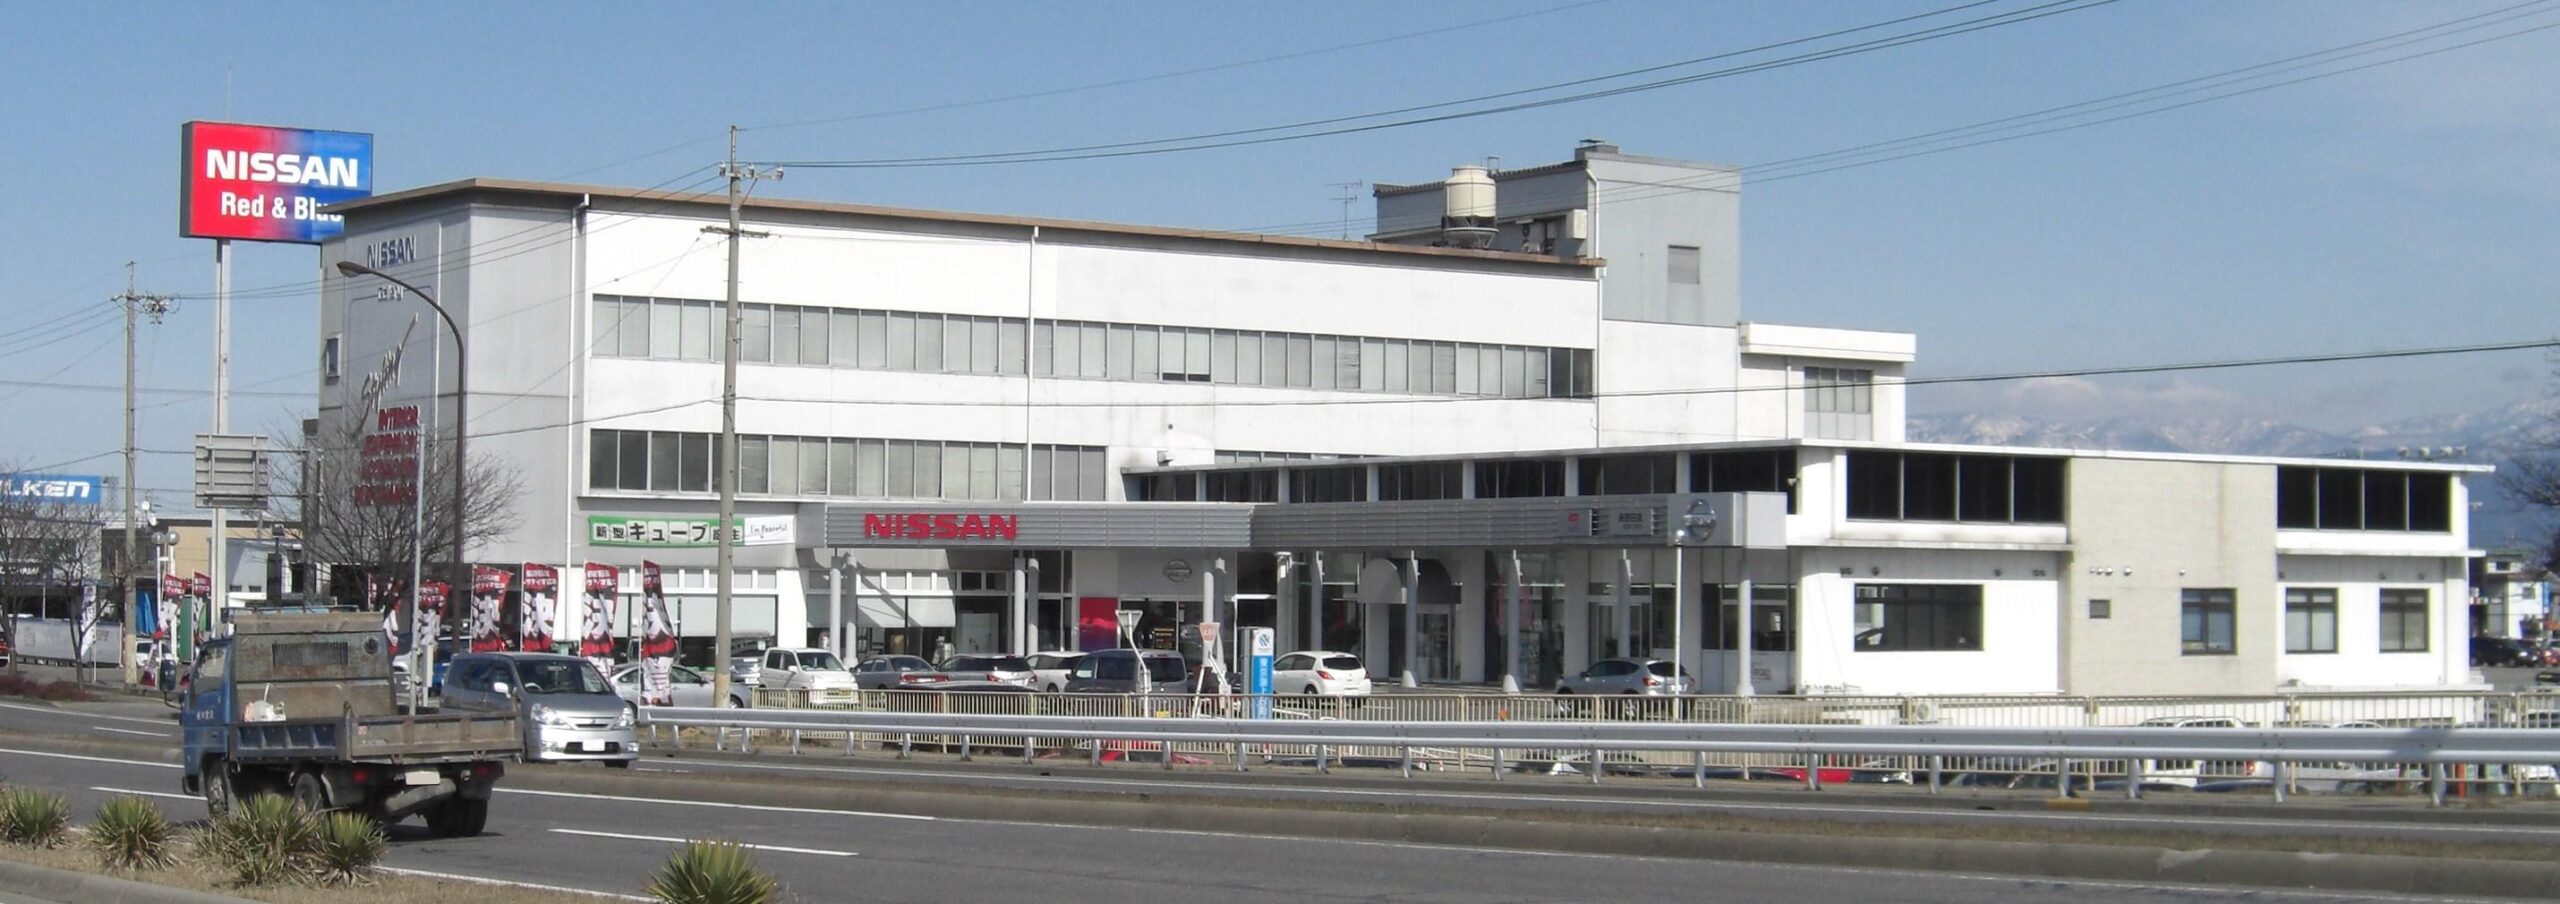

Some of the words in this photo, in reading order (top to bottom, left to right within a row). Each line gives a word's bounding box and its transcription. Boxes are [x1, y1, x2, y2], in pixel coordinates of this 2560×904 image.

[206, 149, 358, 187] NISSAN
[221, 191, 265, 217] Red
[271, 197, 287, 219] &
[367, 236, 417, 269] NISSAN
[0, 479, 90, 498] LKEN
[864, 512, 1018, 541] NISSAN
